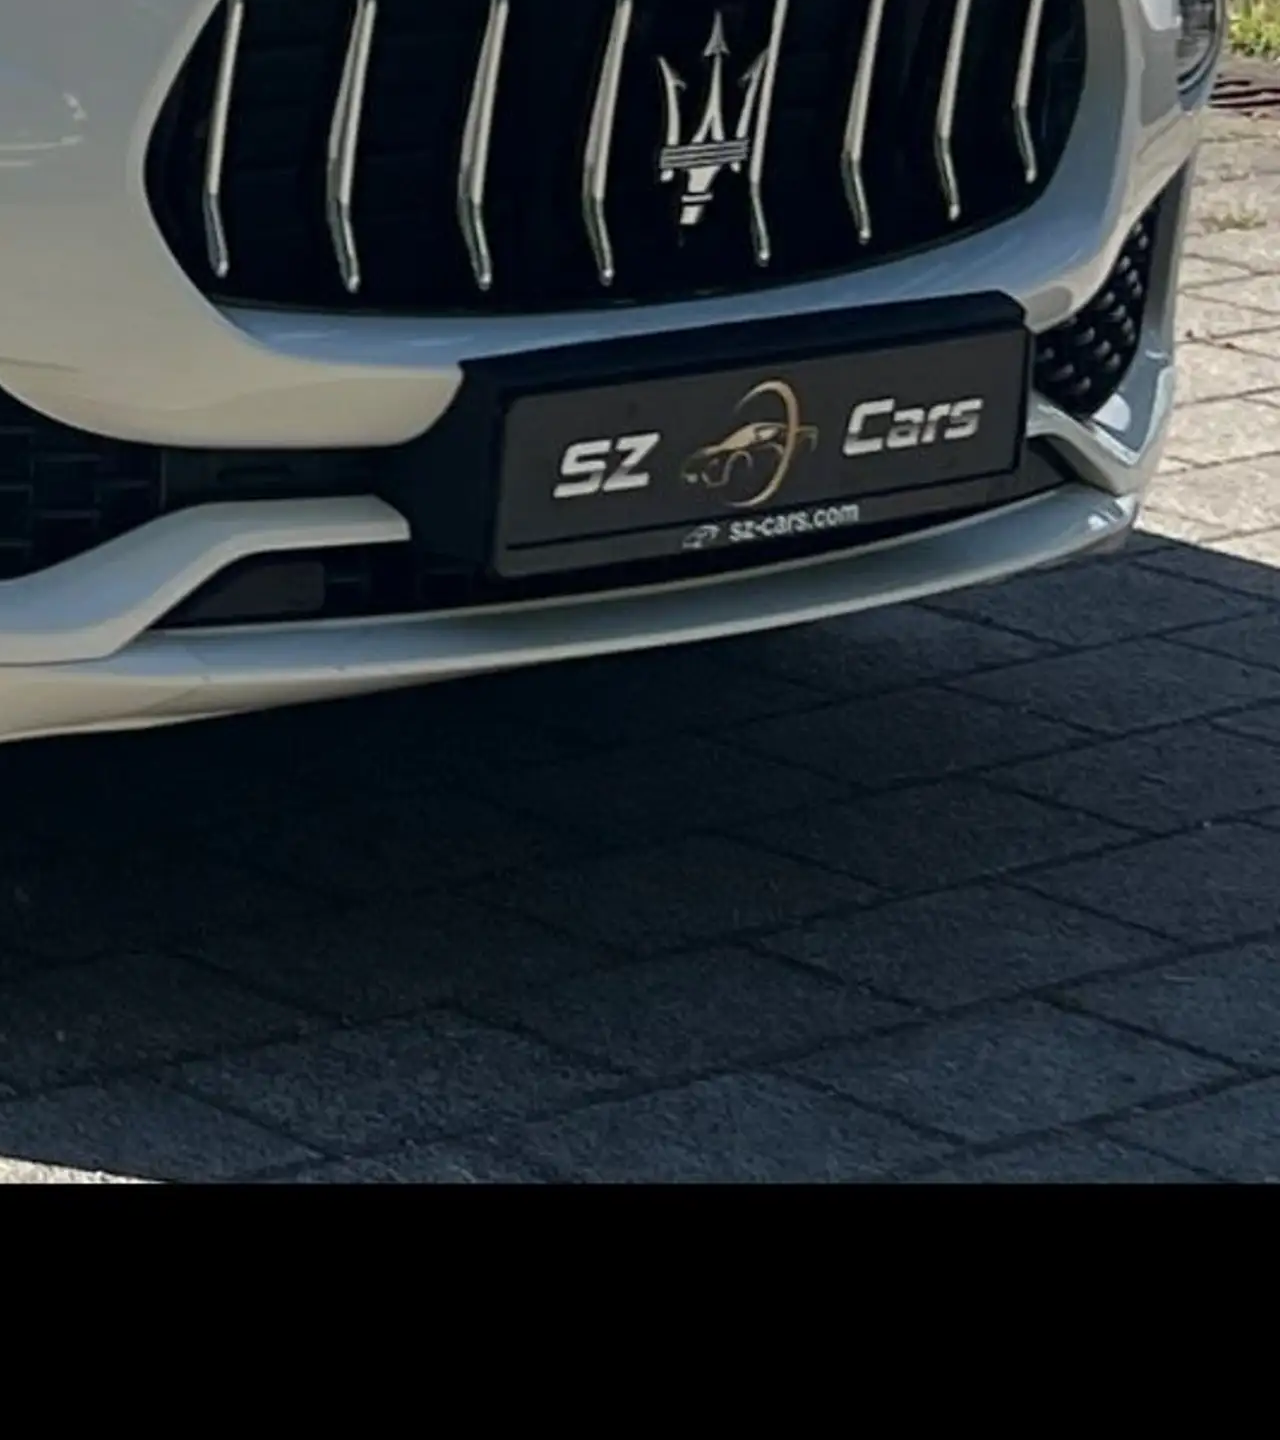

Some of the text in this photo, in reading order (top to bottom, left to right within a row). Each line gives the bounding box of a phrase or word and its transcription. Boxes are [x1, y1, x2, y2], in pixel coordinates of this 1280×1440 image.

[552, 397, 984, 499] SZ Cars
[728, 503, 860, 542] sz-cars.com
